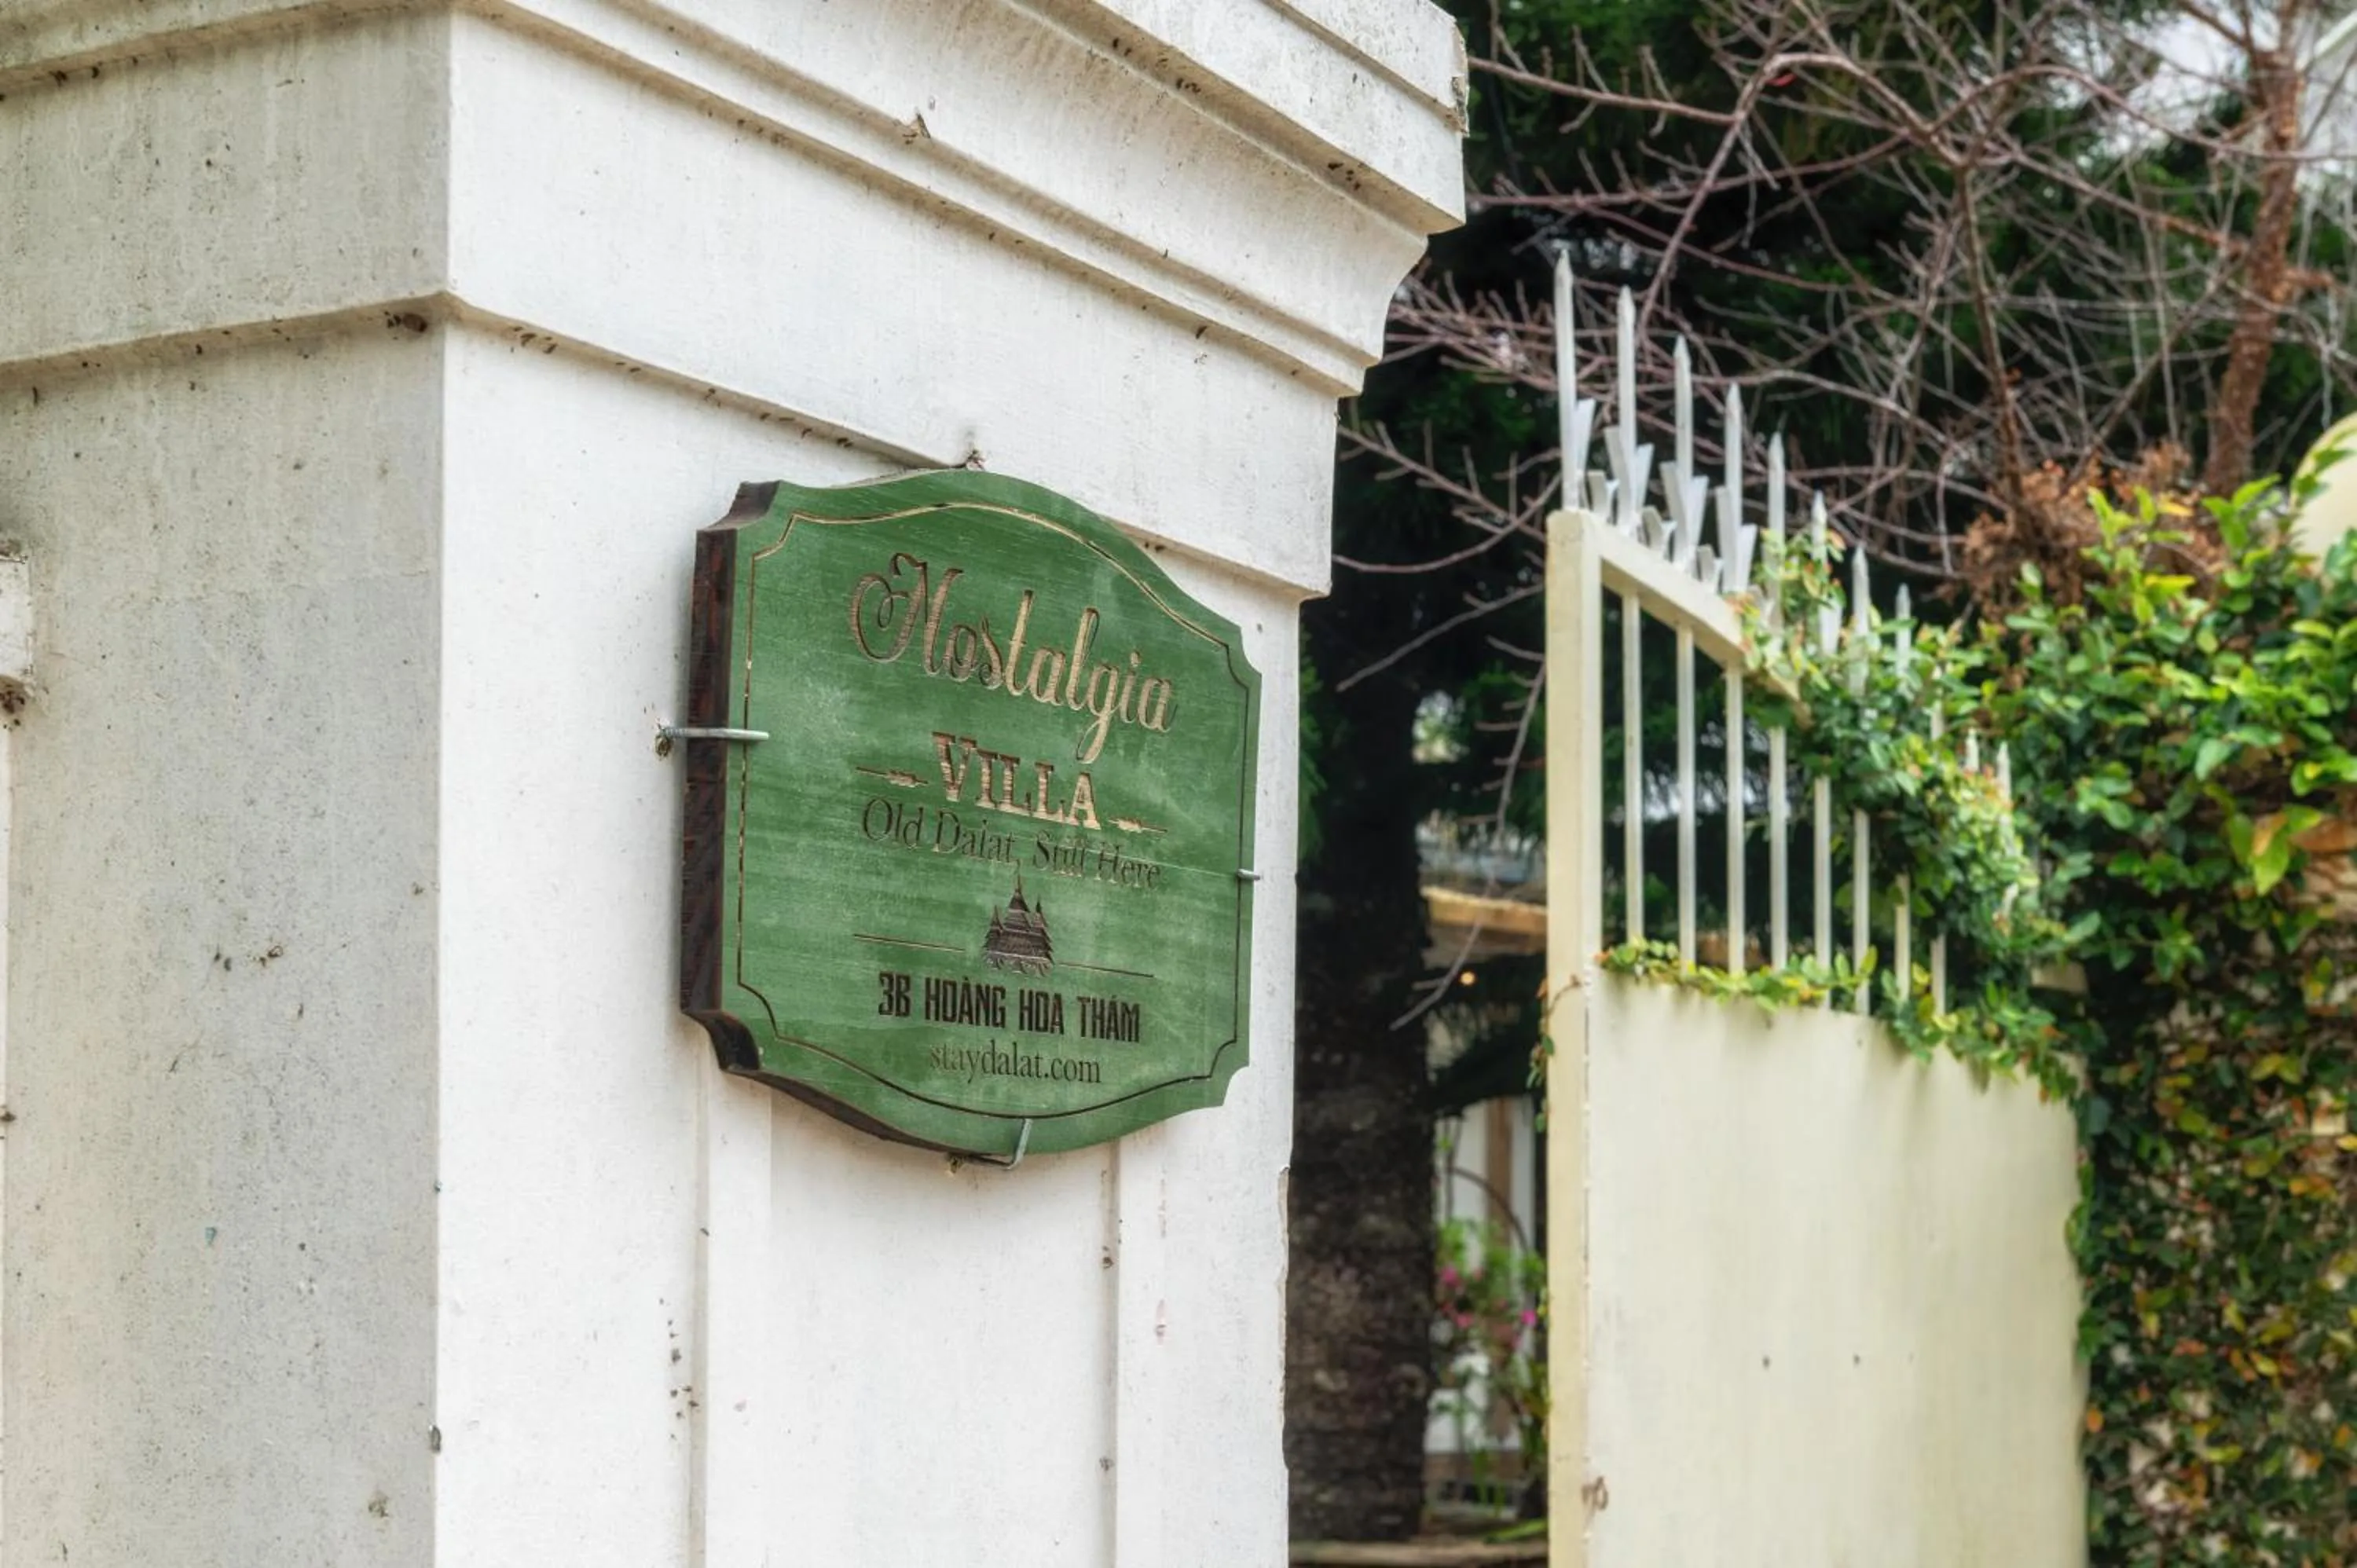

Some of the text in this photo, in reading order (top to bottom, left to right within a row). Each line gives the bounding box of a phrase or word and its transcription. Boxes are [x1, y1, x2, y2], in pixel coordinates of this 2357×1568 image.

[849, 552, 1178, 764] Nostalgia
[932, 731, 1102, 830] VILLA
[862, 795, 923, 849] Old
[1094, 841, 1163, 889] Here
[878, 971, 1141, 1043] 3B HOÀNG HOA THÁM
[929, 1039, 1102, 1084] staydalat.com
